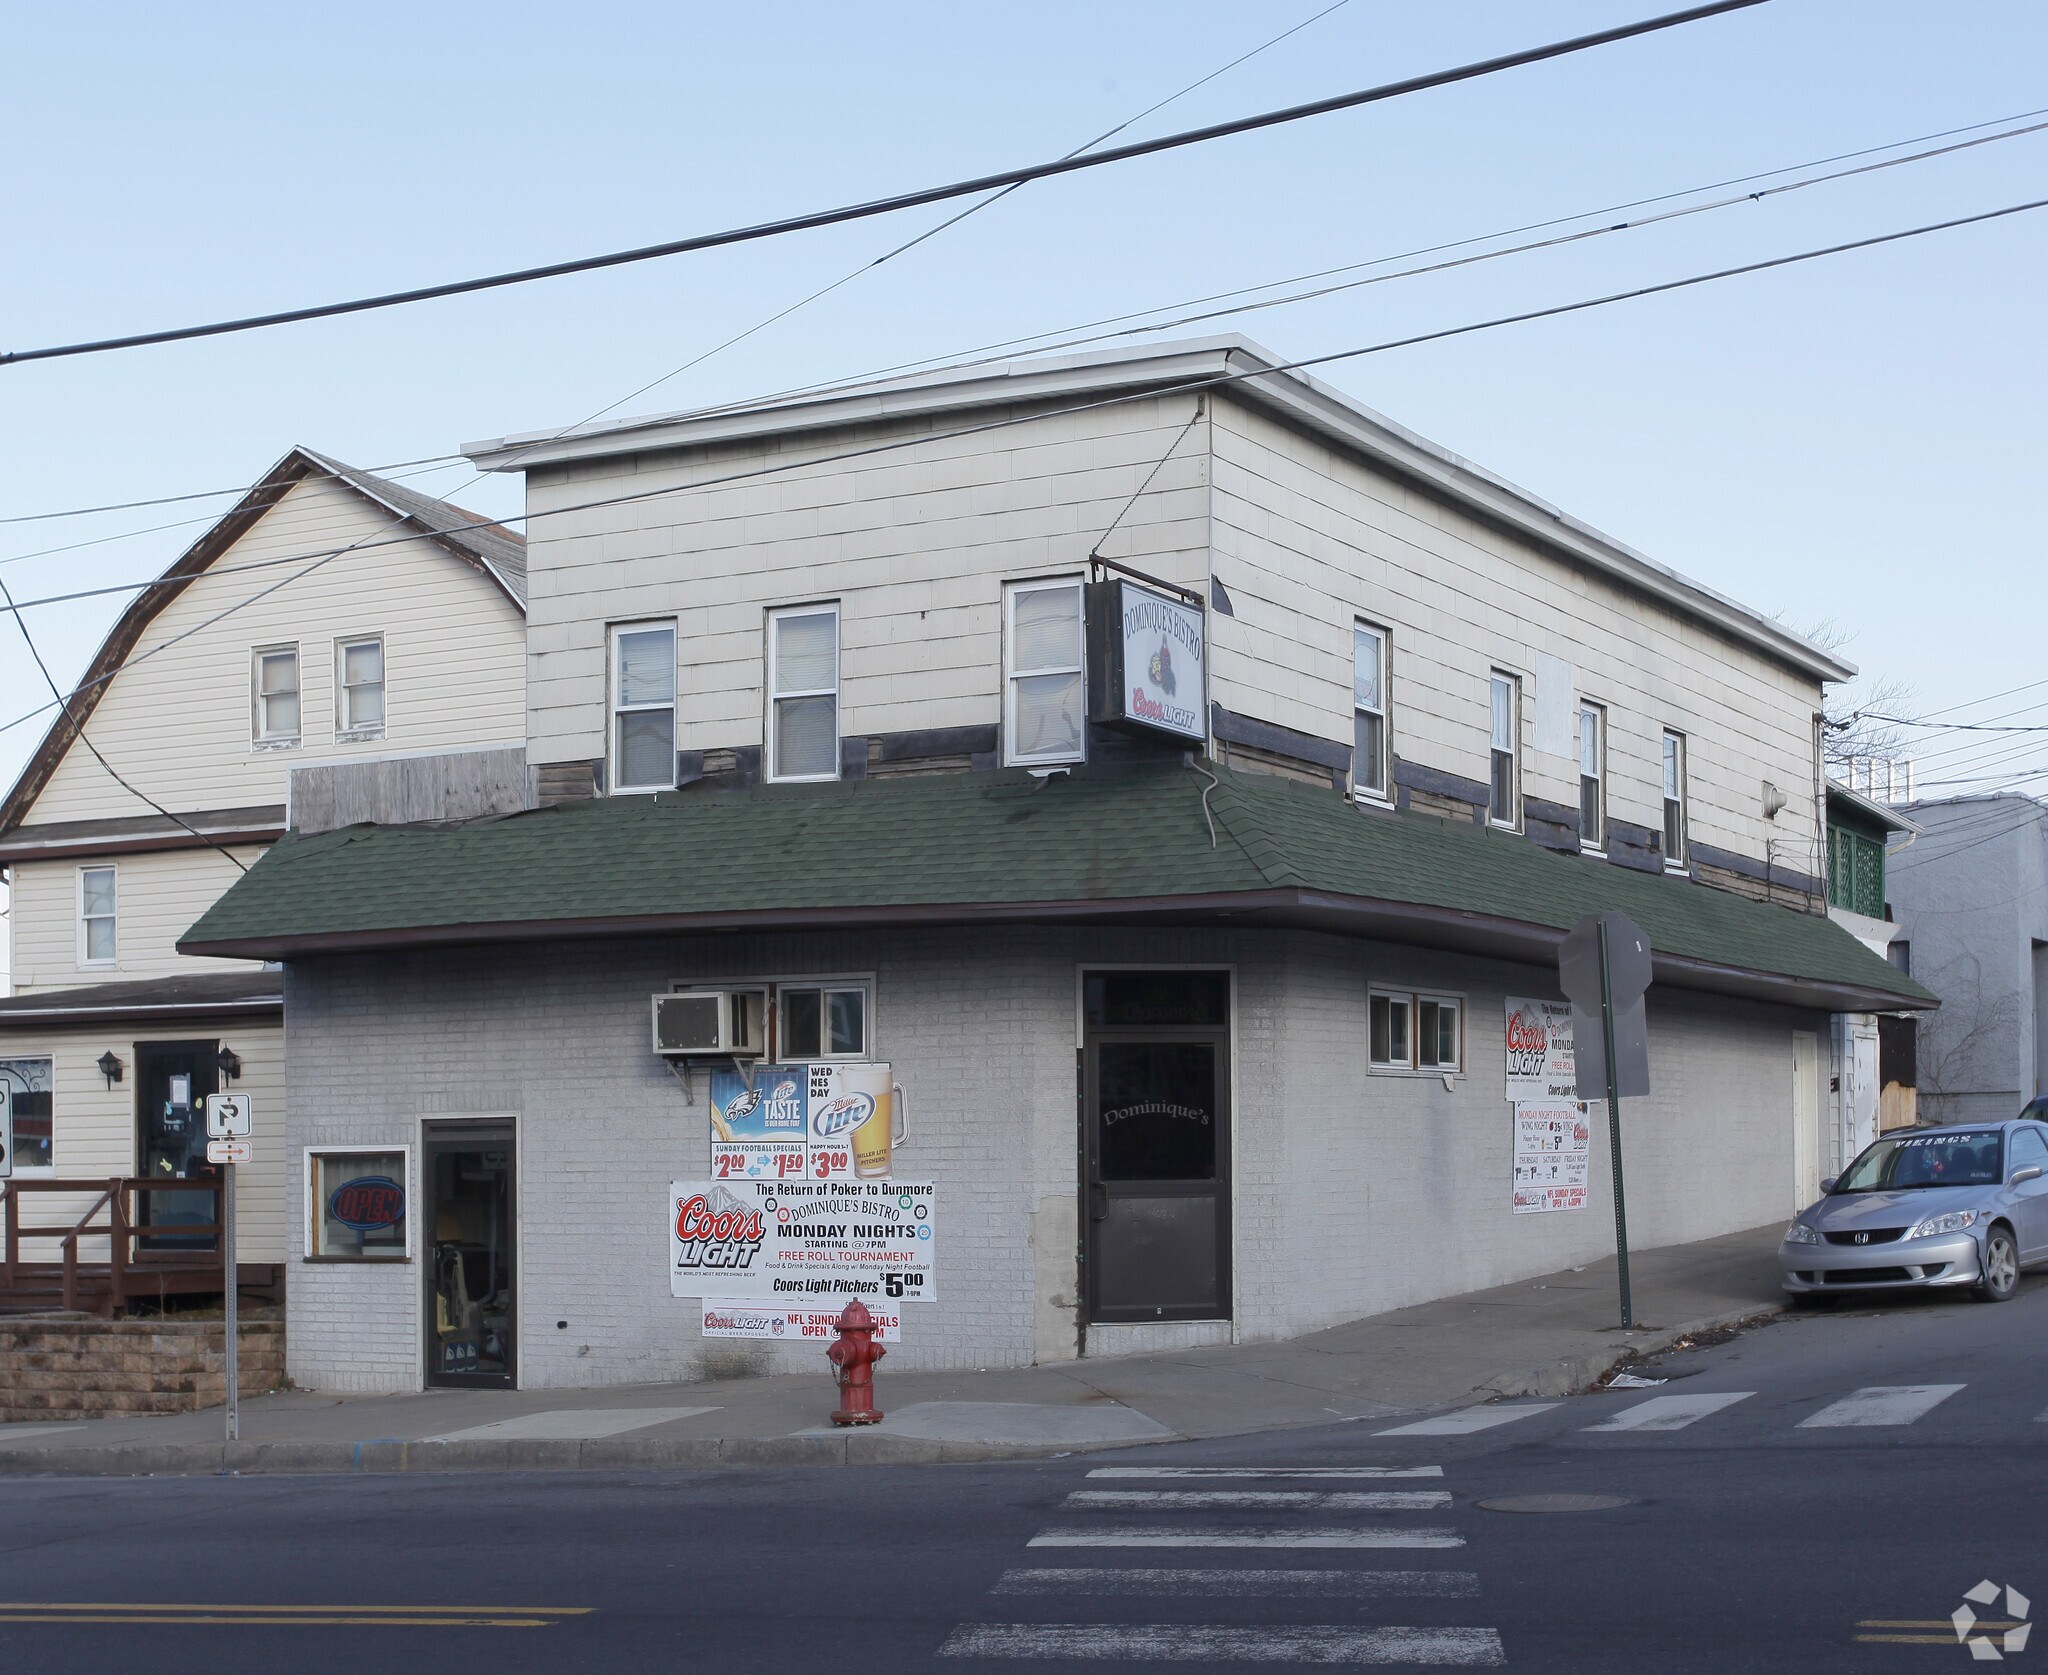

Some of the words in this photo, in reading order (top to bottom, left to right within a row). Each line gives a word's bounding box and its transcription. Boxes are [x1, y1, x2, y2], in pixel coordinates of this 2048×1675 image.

[1124, 602, 1173, 639] DOMINIQUE'S
[1173, 610, 1200, 661] BISTRO
[1132, 686, 1164, 721] Coors
[1163, 704, 1195, 729] LIGHT
[1507, 1009, 1547, 1053] Coors
[1551, 1039, 1574, 1050] MONDA
[1507, 1052, 1546, 1076] LIGHT
[1551, 1061, 1562, 1069] FREE
[1563, 1062, 1573, 1070] ROLL
[811, 1067, 833, 1076] WED
[811, 1079, 829, 1087] NES
[810, 1089, 830, 1098] DAY
[1548, 1084, 1561, 1095] Coors
[1560, 1085, 1571, 1096] Light
[763, 1099, 801, 1120] TASTE
[830, 1097, 858, 1111] Miller
[1104, 1099, 1210, 1126] Dominique's
[1519, 1110, 1538, 1119] MONDAY
[1538, 1110, 1553, 1119] NIGHT
[1553, 1110, 1576, 1119] FOOTBALL
[823, 1103, 867, 1137] Lite
[1573, 1122, 1589, 1140] Coors
[716, 1144, 741, 1152] SUNDAY
[741, 1144, 772, 1152] FOOTBALL
[772, 1144, 802, 1152] SPECIALS
[1894, 1135, 1972, 1148] VIKINGS
[857, 1151, 873, 1159] MILLER
[860, 1156, 886, 1165] PITCHERS
[756, 1183, 774, 1195] The
[777, 1183, 813, 1195] Return
[816, 1183, 828, 1195] of
[831, 1183, 863, 1195] Poker
[866, 1184, 878, 1195] to
[882, 1183, 933, 1195] Dunmore
[1554, 1188, 1569, 1198] SUNDAY
[1569, 1188, 1587, 1197] SPECIALS
[337, 1187, 400, 1223] OPEN
[1552, 1198, 1562, 1208] OPEN
[791, 1199, 859, 1221] DOMINIQUE'S
[861, 1199, 900, 1221] BISTRO
[675, 1193, 766, 1243] Coors
[777, 1225, 847, 1238] MONDAY
[853, 1225, 916, 1238] NIGHTS
[677, 1241, 761, 1268] LIGHT
[778, 1251, 805, 1260] FREE
[807, 1251, 835, 1261] ROLL
[838, 1251, 915, 1261] TOURNAMENT
[831, 1263, 850, 1271] Along
[773, 1278, 804, 1292] Coors
[805, 1279, 831, 1294] Light
[833, 1279, 879, 1293] Pitchers
[704, 1312, 735, 1329] Coors
[734, 1318, 769, 1329] LIGHT
[787, 1314, 804, 1325] NFL
[808, 1314, 841, 1326] SUNDA
[870, 1316, 899, 1327] CIALS
[802, 1326, 827, 1337] OPEN
